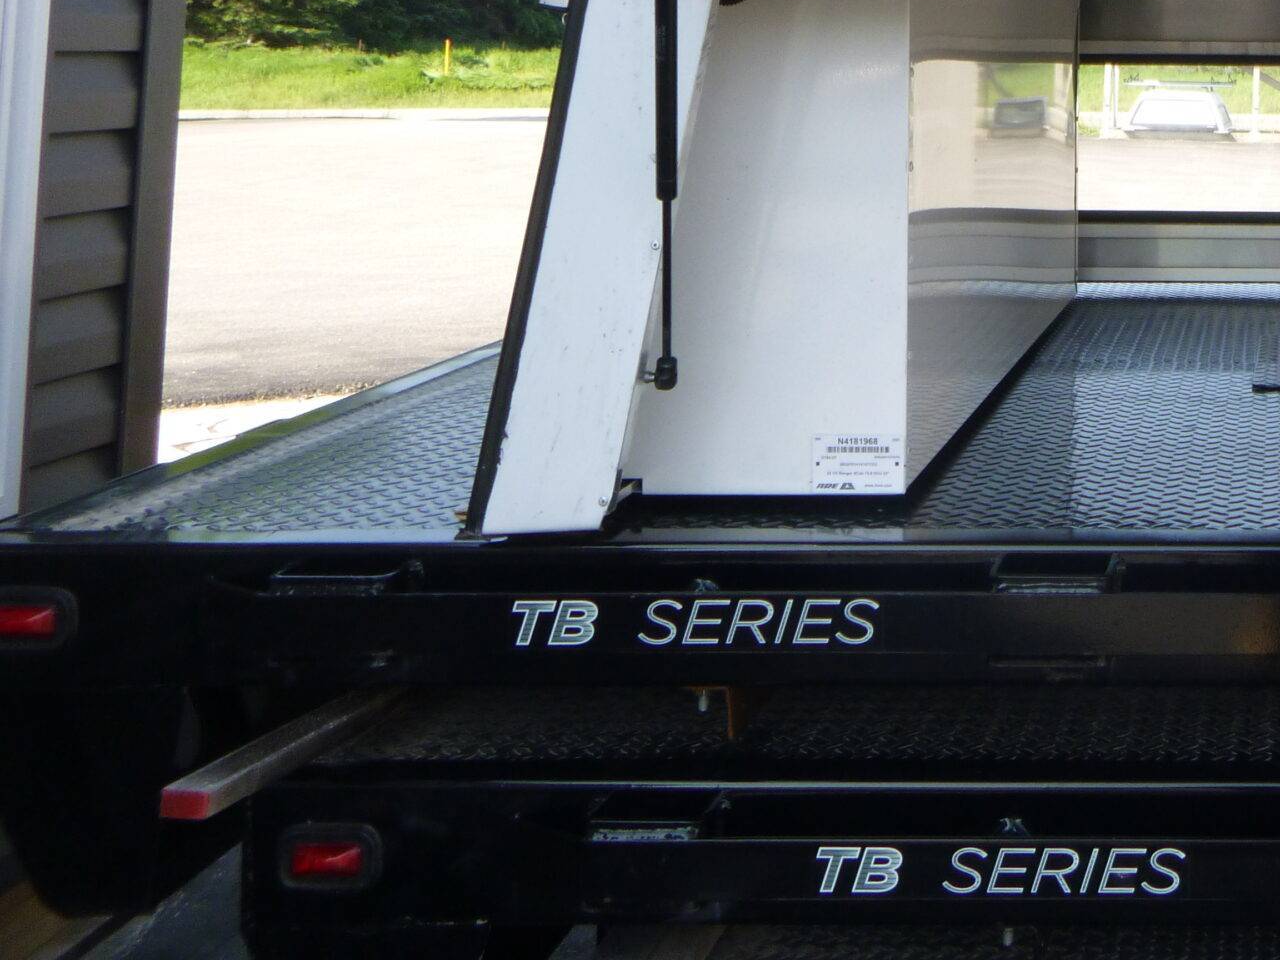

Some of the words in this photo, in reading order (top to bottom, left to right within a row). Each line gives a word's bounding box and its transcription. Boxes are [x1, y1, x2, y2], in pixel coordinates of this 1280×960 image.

[512, 599, 600, 646] TB
[638, 598, 881, 645] SERIES
[815, 846, 904, 894] TB
[942, 846, 1187, 895] SERIES
